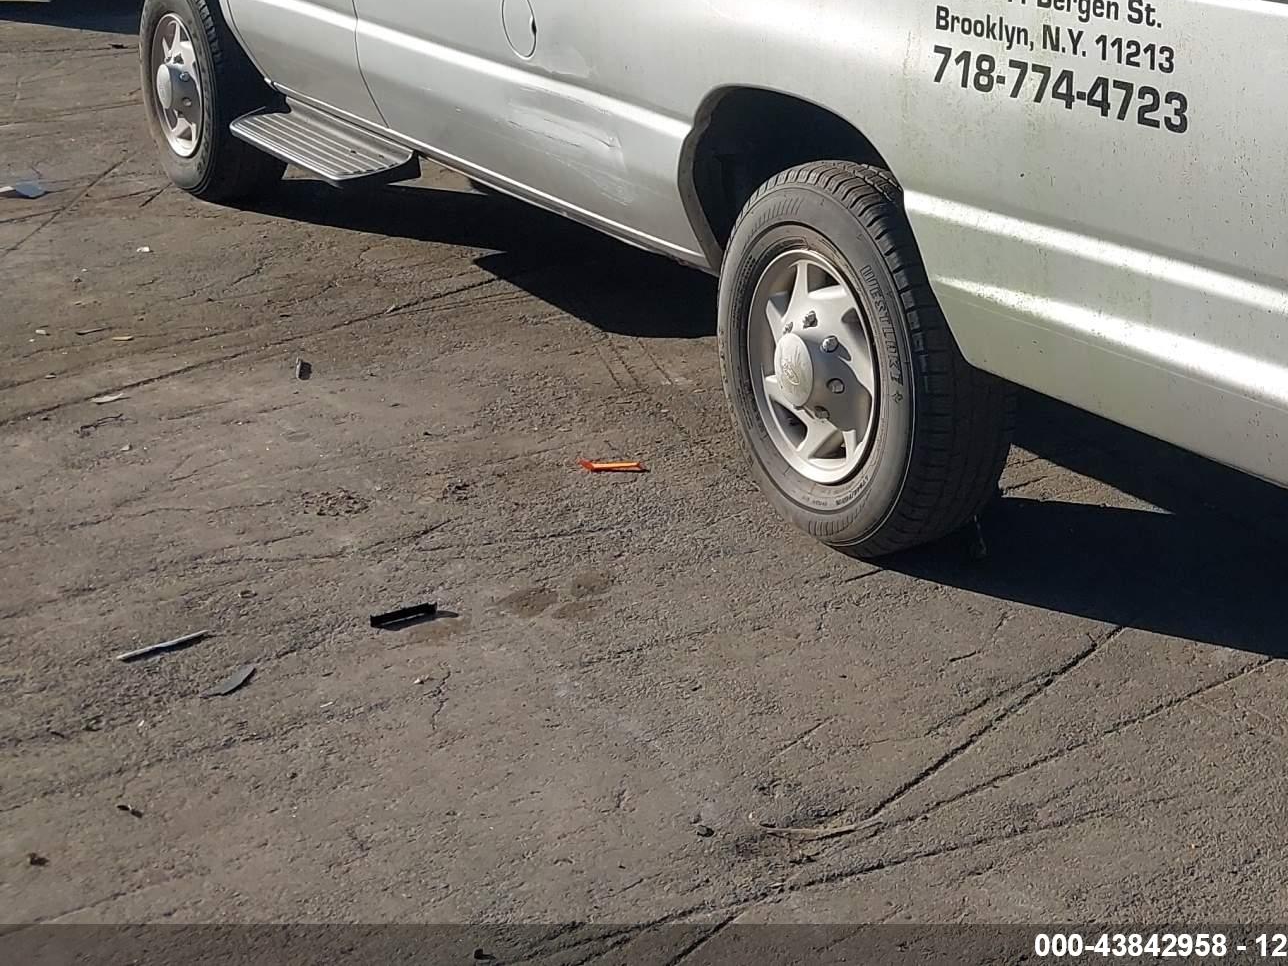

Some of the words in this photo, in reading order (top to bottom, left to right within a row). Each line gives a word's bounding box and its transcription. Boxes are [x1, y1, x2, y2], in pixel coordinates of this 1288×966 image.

[935, 5, 1034, 52] Brooklyn,
[1042, 24, 1087, 58] N.Y.
[1095, 34, 1175, 74] 11213
[933, 45, 1188, 134] 718-774-4723
